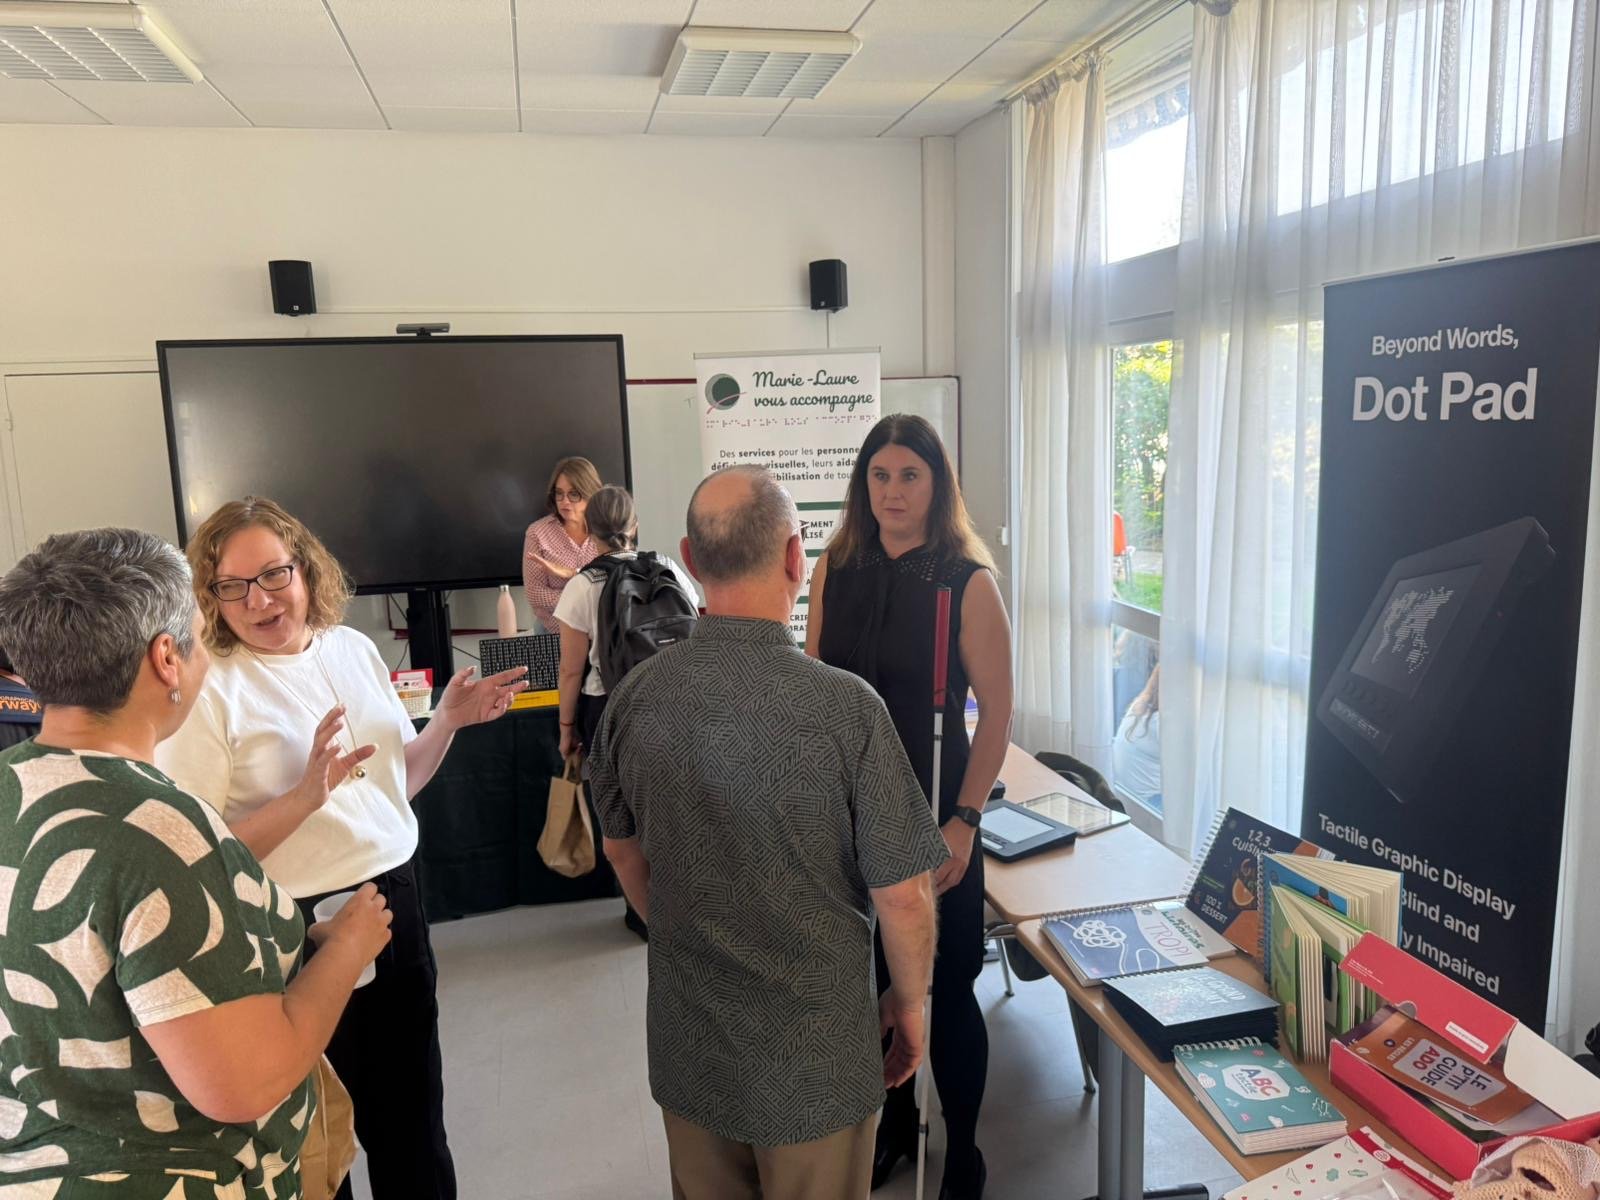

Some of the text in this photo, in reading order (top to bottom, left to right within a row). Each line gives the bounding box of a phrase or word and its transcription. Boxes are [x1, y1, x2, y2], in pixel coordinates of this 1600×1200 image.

[1372, 324, 1519, 358] Beyond Words,
[754, 392, 875, 413] vous accompagne
[1353, 367, 1538, 421] Dot Pad
[719, 447, 860, 459] Des services pour les personne
[812, 459, 833, 468] leurs
[824, 471, 835, 480] de
[1318, 813, 1516, 921] Tactile Graphic Display
[1443, 912, 1480, 943] and
[1417, 935, 1499, 996] Impaired
[1412, 1046, 1440, 1070] ADO
[1421, 1057, 1457, 1086] GUIDE
[1240, 1069, 1281, 1097] ABC
[1470, 1074, 1492, 1090] LE
